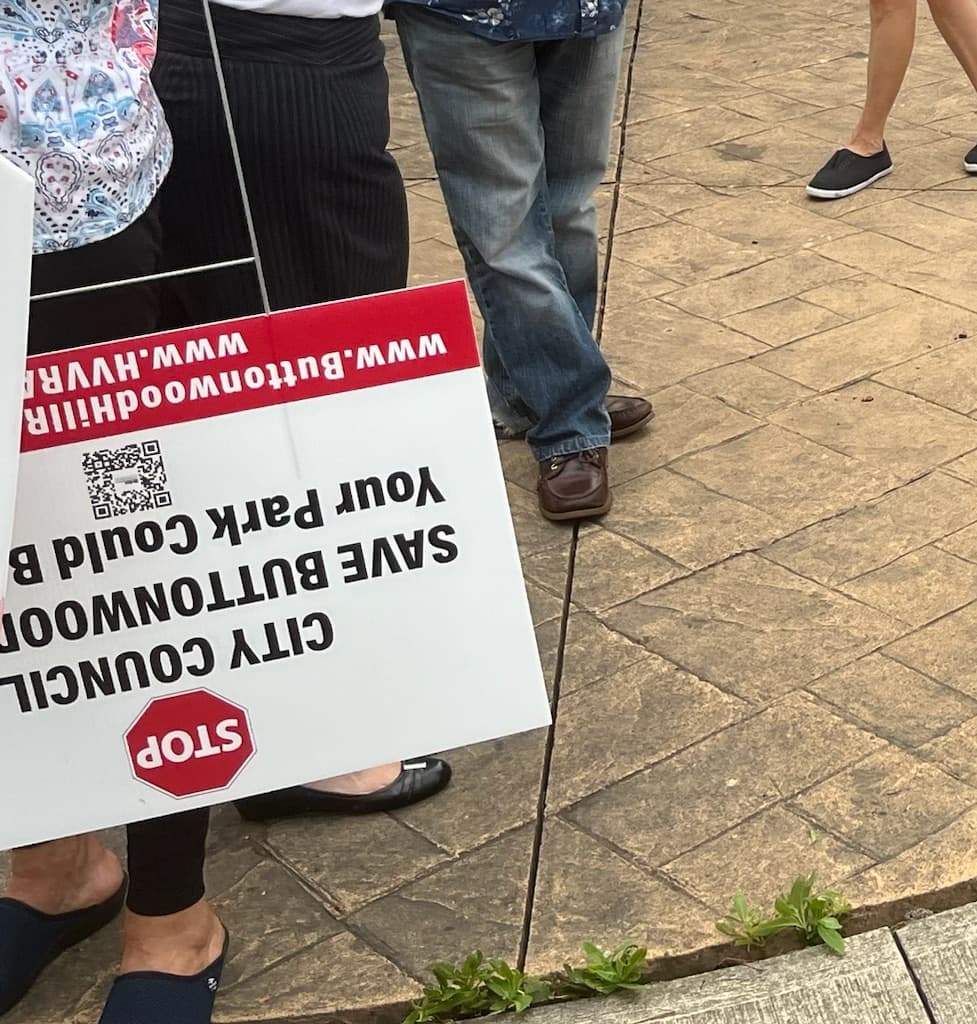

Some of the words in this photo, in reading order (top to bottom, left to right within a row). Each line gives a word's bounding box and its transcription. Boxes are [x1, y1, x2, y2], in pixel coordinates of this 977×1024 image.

[24, 334, 447, 434] www.ButtonwoodHillR
[206, 489, 323, 546] Park
[336, 467, 445, 515] Your
[9, 544, 43, 585] B
[52, 515, 197, 580] Could
[338, 525, 457, 583] SAVE
[231, 613, 333, 669] CITY
[0, 638, 214, 712] COUNCIL
[136, 719, 242, 769] STOP
